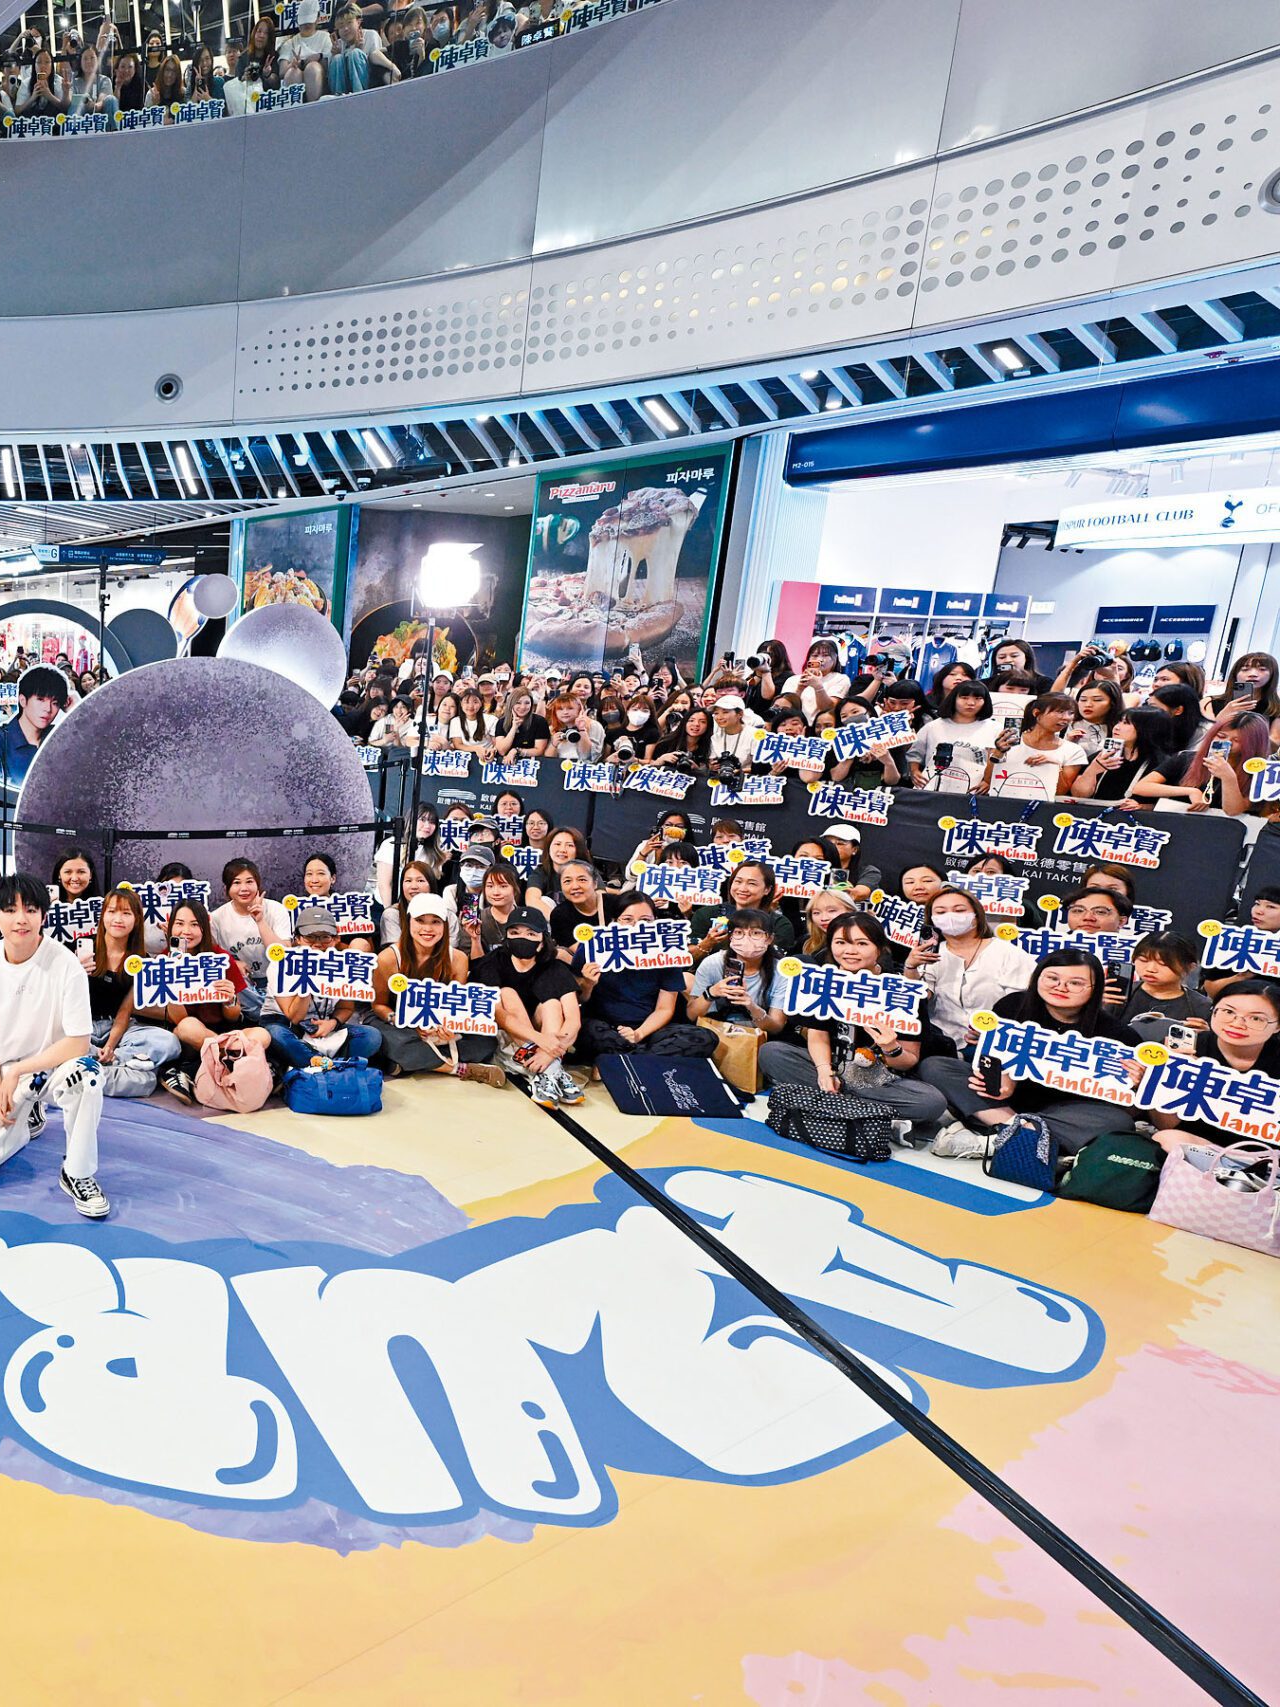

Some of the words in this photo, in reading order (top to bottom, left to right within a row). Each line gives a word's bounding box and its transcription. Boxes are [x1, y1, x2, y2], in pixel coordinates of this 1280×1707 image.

[521, 26, 555, 47] 陳卓賢
[433, 40, 489, 73] 陳卓賢
[176, 99, 224, 123] 陳卓賢
[257, 85, 305, 111] 陳卓賢
[9, 117, 55, 138] 陳卓賢
[120, 107, 165, 129] 陳卓賢
[665, 467, 716, 484] 피자마루
[548, 480, 617, 501] Pizzamaru
[304, 522, 333, 536] 피자마루
[1087, 513, 1150, 528] FOOTBALL
[1156, 509, 1195, 521] CLUB
[50, 548, 58, 559] G
[754, 733, 830, 763] 陳卓賢
[833, 712, 909, 761] 陳卓賢
[625, 767, 695, 791] 陳卓賢
[810, 786, 894, 817] 陳卓賢
[844, 811, 887, 825] IanChan
[440, 819, 470, 851] 陳卓
[946, 821, 1042, 854] 陳卓賢
[1056, 819, 1166, 857] 陳卓賢
[1023, 857, 1092, 874] 啟德零售
[1100, 848, 1159, 868] IanChan
[638, 866, 724, 900] 陳卓賢
[1022, 869, 1043, 879] KAI
[1046, 872, 1070, 882] TAK
[983, 901, 1024, 915] nChan
[336, 922, 374, 934] anChan
[586, 922, 690, 969] 陳卓賢
[1205, 927, 1280, 971] 陳卓
[277, 948, 375, 995] 陳卓賢
[635, 954, 691, 968] IanChan
[137, 955, 228, 1007] 陳卓賢
[320, 982, 375, 1000] IanChan
[787, 966, 924, 1019] 陳卓賢
[399, 980, 499, 1026] 陳卓賢
[846, 1007, 919, 1033] IanChan
[980, 1022, 1136, 1085] 陳卓賢
[1045, 1069, 1133, 1105] IanChan
[1140, 1056, 1280, 1123] 陳卓
[1219, 1112, 1280, 1144] IanC
